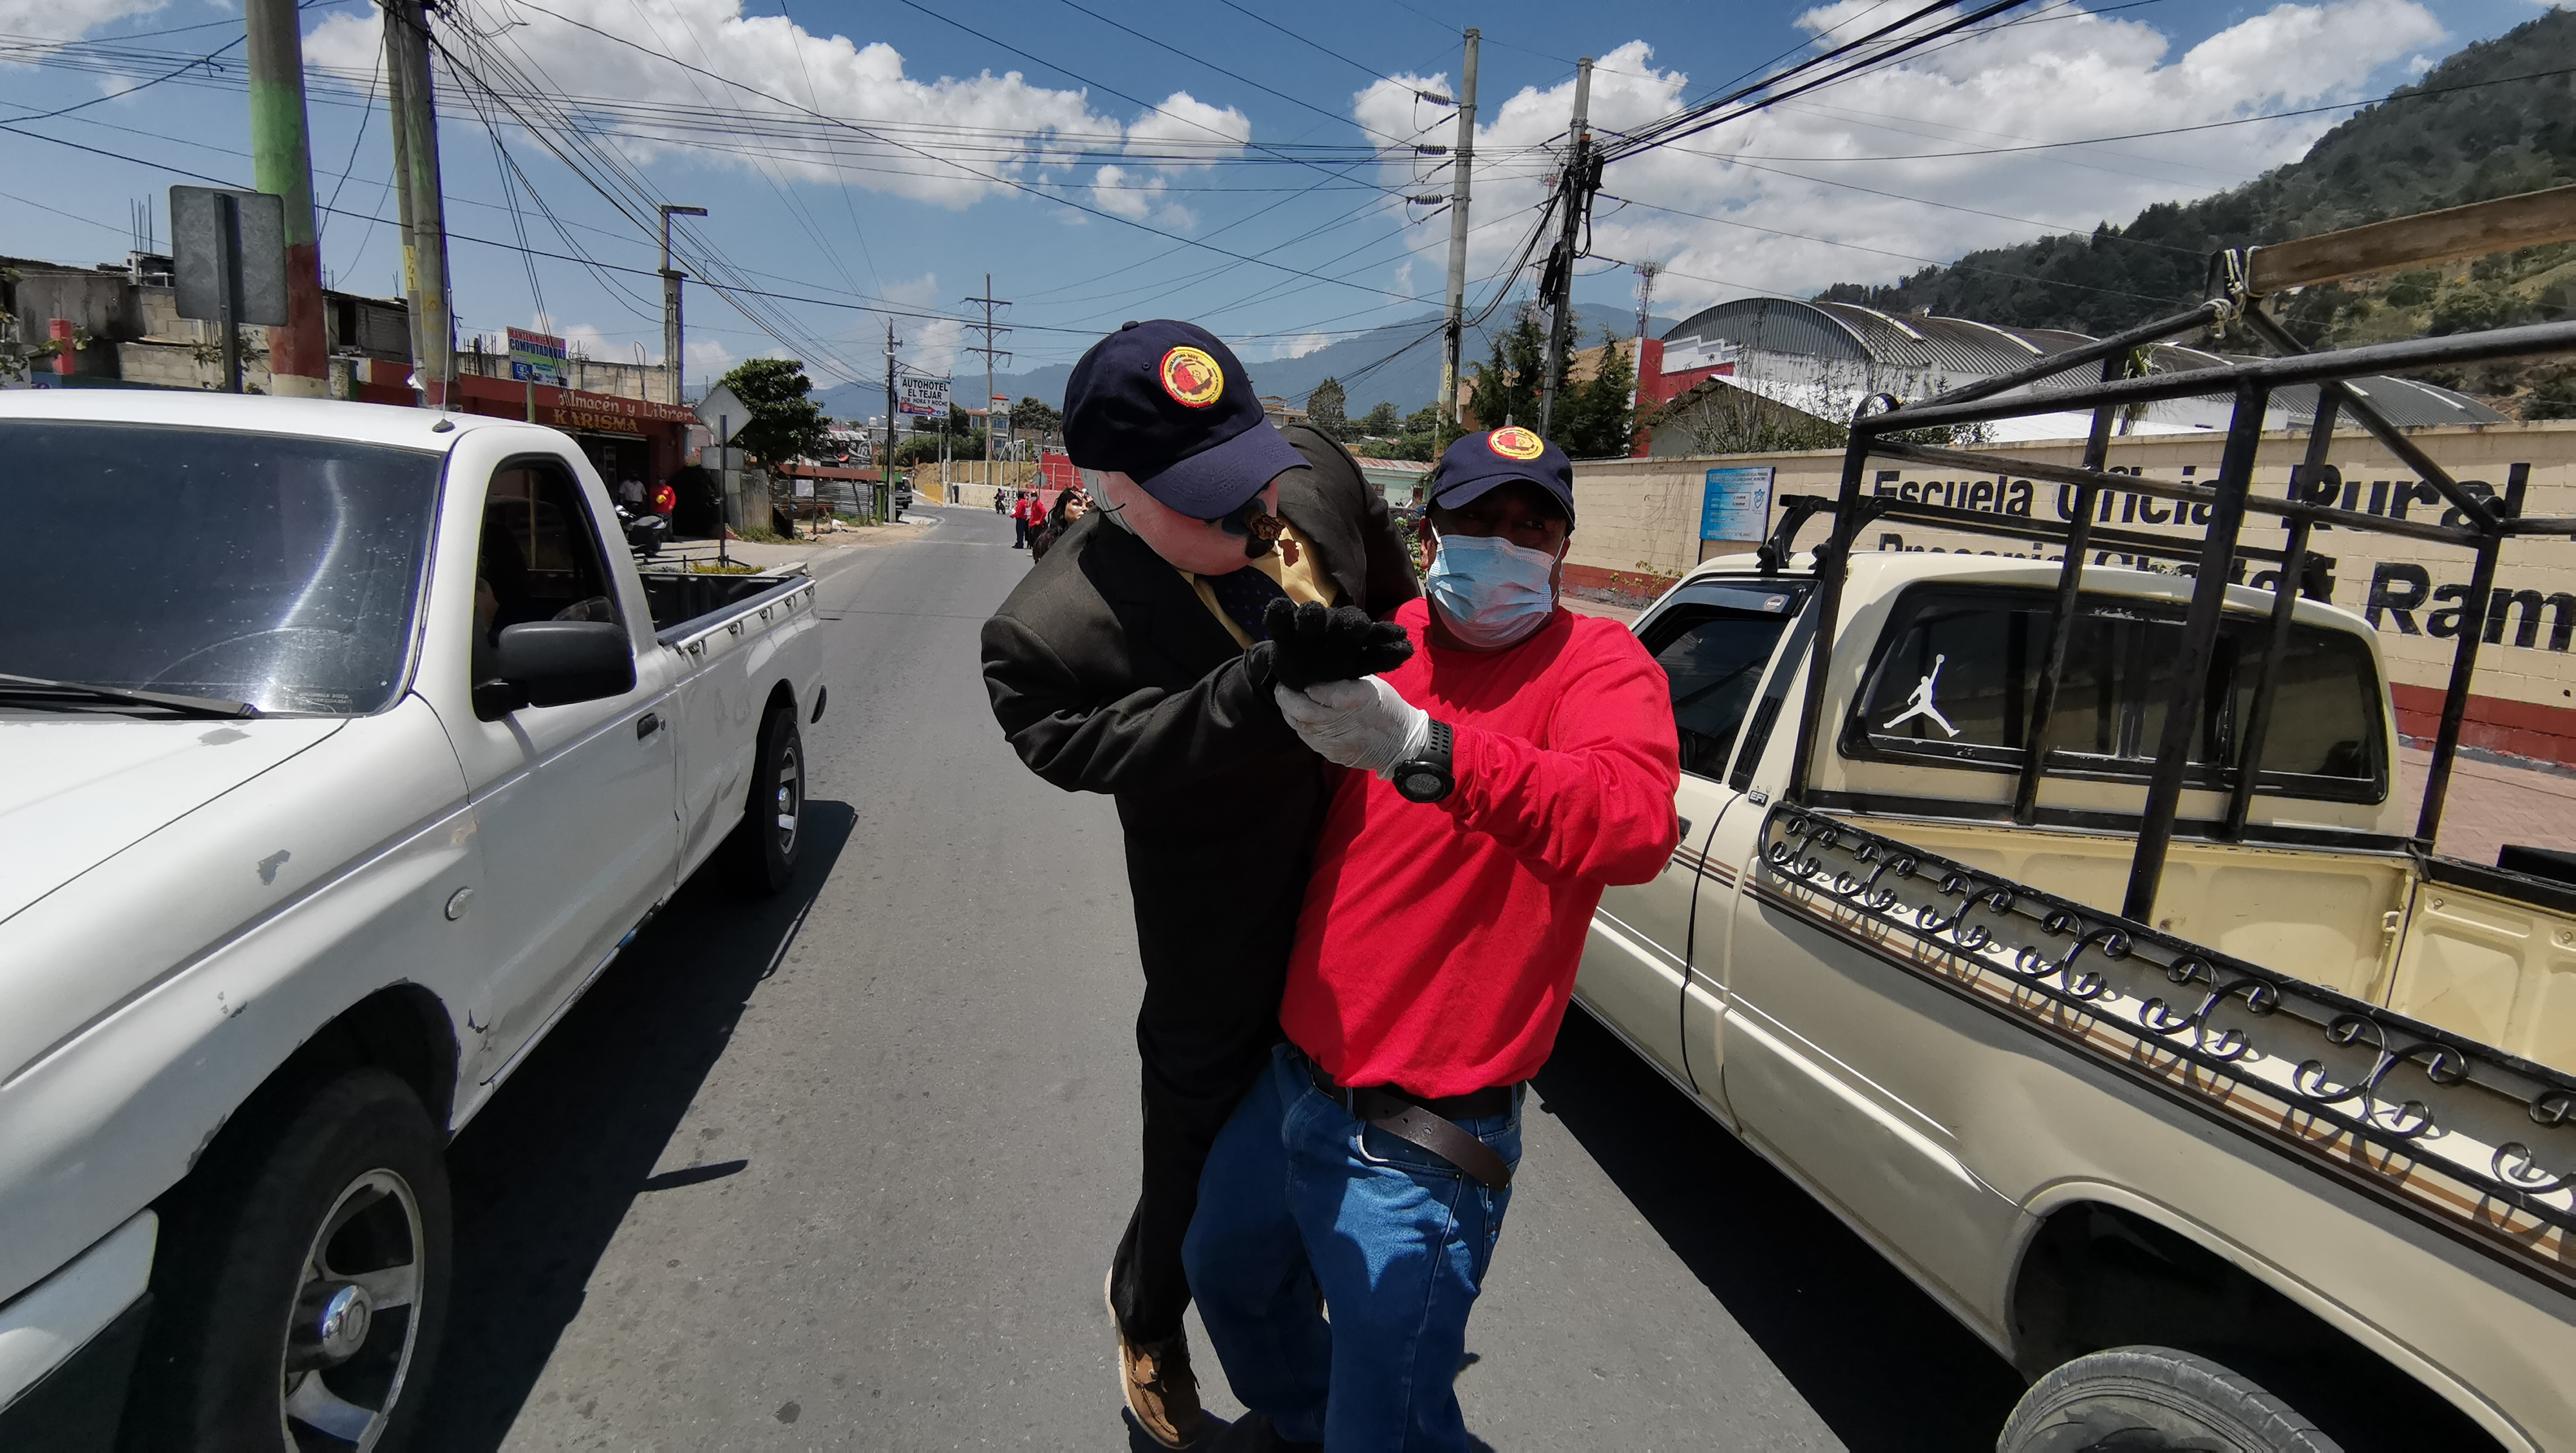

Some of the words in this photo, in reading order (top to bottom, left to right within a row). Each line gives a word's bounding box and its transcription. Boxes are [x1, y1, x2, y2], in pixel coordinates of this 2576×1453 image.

[902, 379, 948, 392] AUTOHOTEL
[908, 388, 916, 397] EL
[919, 390, 942, 399] TEJAR
[627, 403, 636, 417] y
[1873, 470, 2034, 518] Escuela
[1750, 791, 1766, 803] EFI
